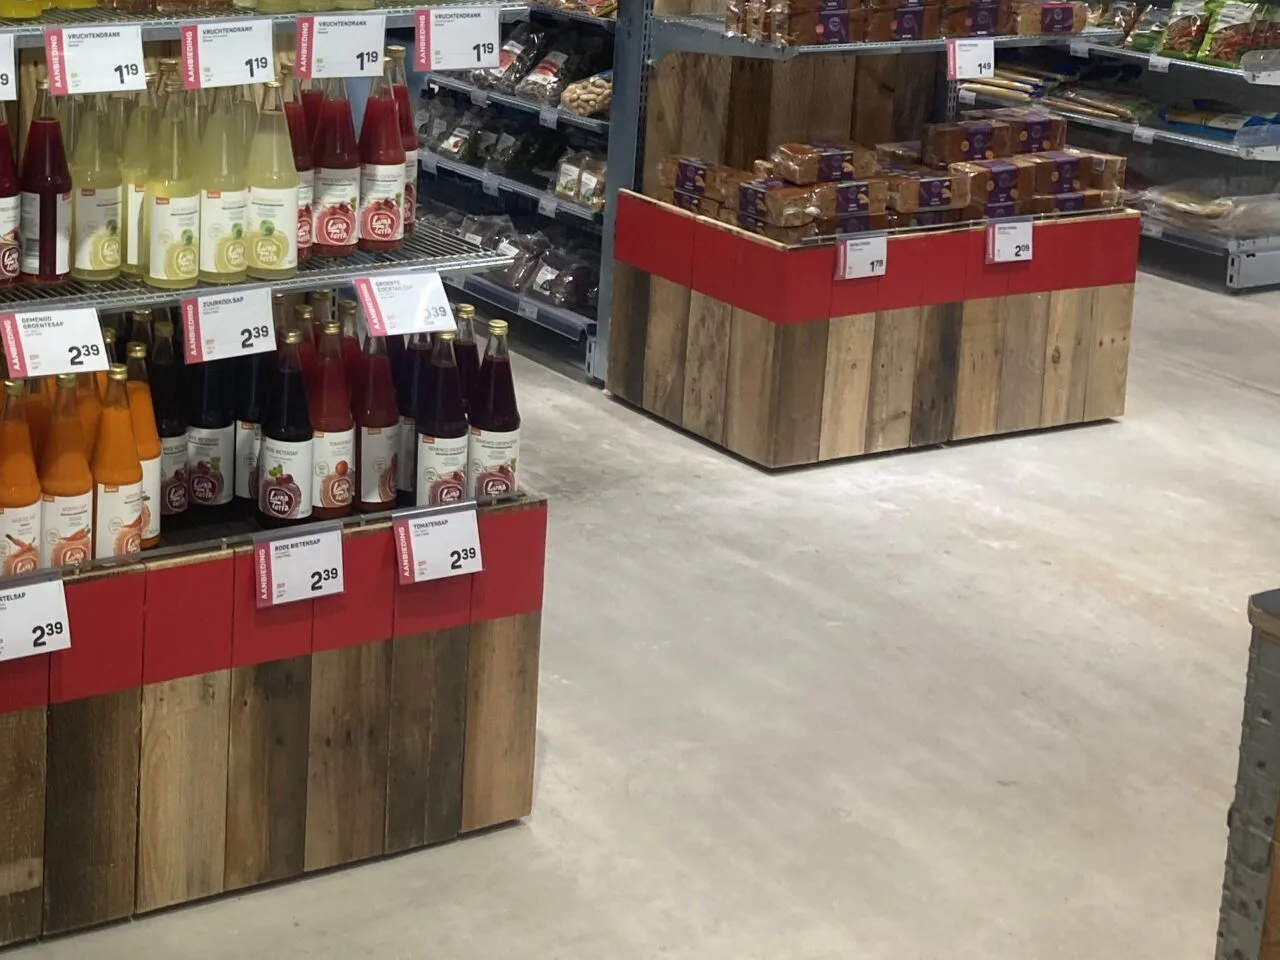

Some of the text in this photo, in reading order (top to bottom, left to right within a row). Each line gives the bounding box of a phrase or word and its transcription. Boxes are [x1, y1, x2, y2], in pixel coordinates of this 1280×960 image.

[68, 32, 121, 40] VRUCHTENDRANK
[202, 26, 253, 35] VRUCHTENDRANK
[300, 22, 309, 72] AANBIEDING
[50, 35, 62, 88] AANBIEDING
[186, 31, 195, 82] AANBIEDING
[22, 321, 64, 329] GROENTESAP
[203, 297, 244, 308] ZUURKOOLSAP
[360, 283, 381, 330] AANBIEDING
[3, 320, 21, 371] AANBIEDING
[187, 304, 197, 356] AANBIEDING
[290, 539, 321, 549] BIETENSAP
[413, 520, 448, 530] TOMATENSAP
[259, 549, 268, 600] AANBIEDING
[398, 526, 410, 577] AANBIEDING
